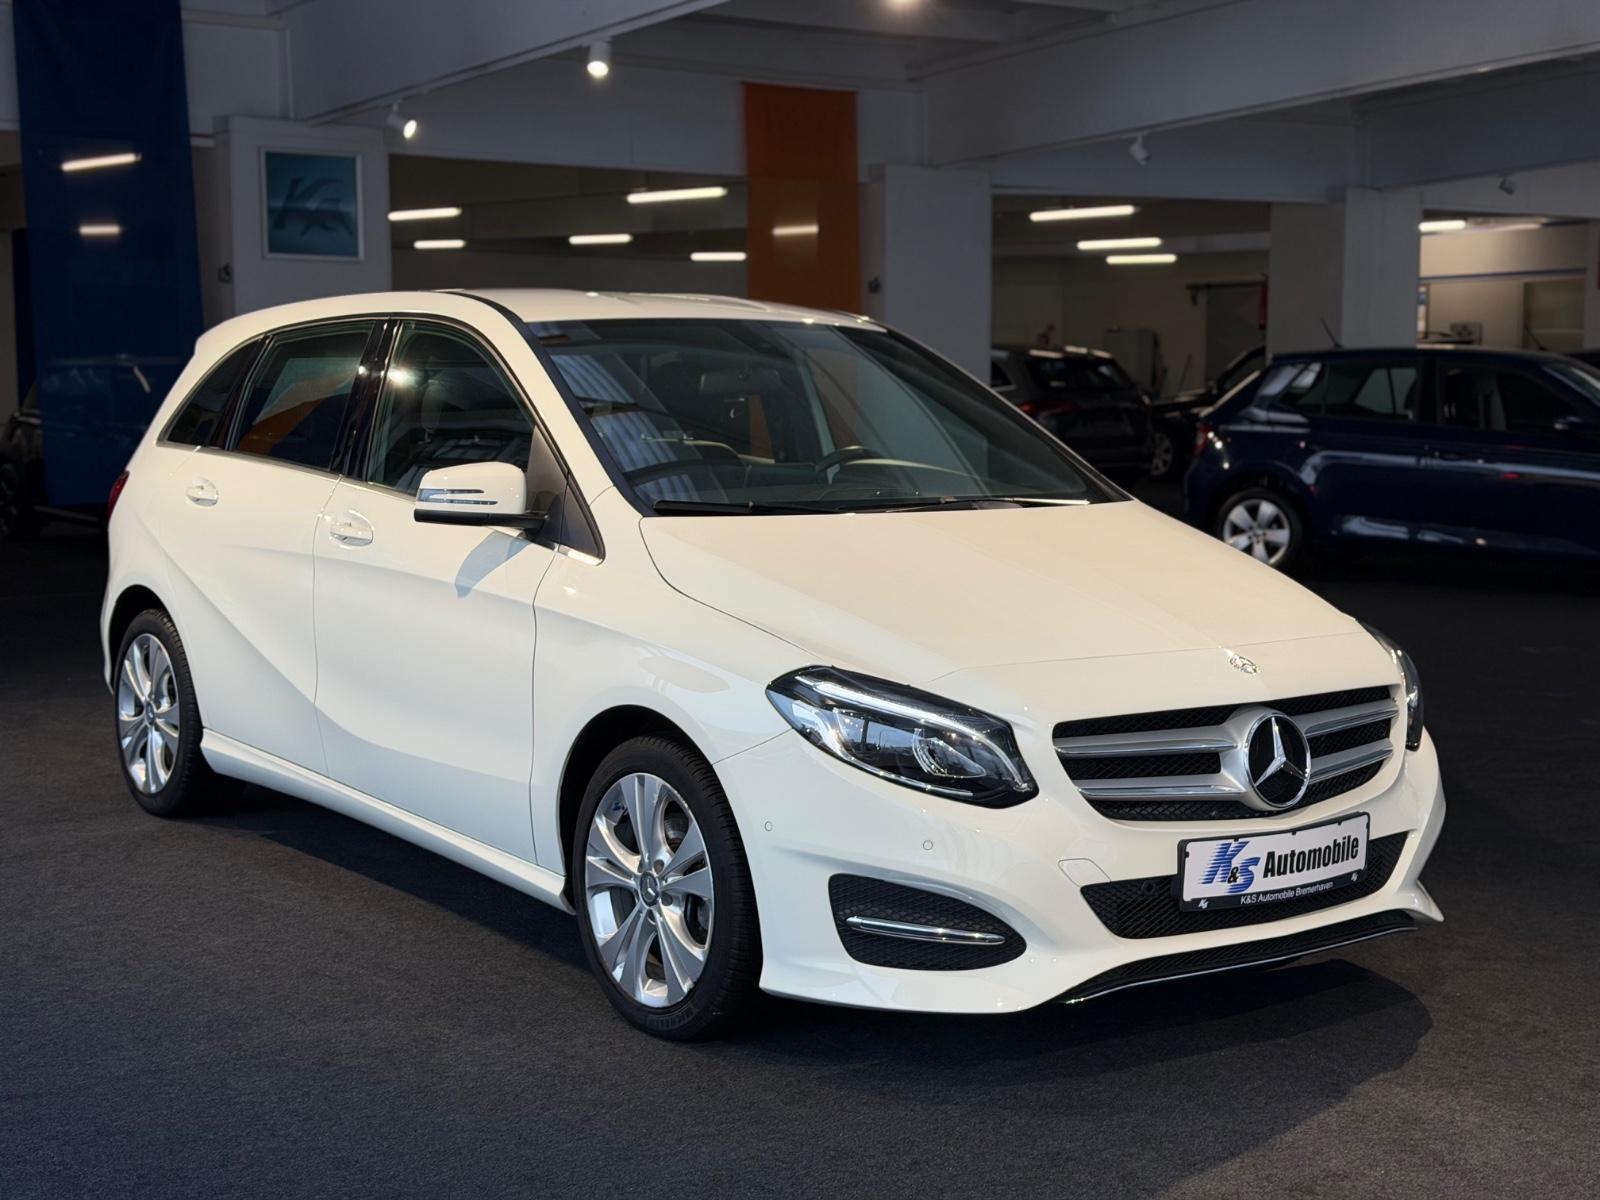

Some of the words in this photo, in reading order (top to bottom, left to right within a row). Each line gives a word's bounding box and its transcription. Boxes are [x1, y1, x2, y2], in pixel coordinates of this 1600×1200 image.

[1199, 841, 1261, 894] K&S
[1263, 835, 1359, 878] Automobile
[1240, 894, 1257, 905] K&S
[1257, 889, 1295, 902] Automobile
[1295, 881, 1334, 897] Bremerhaven
